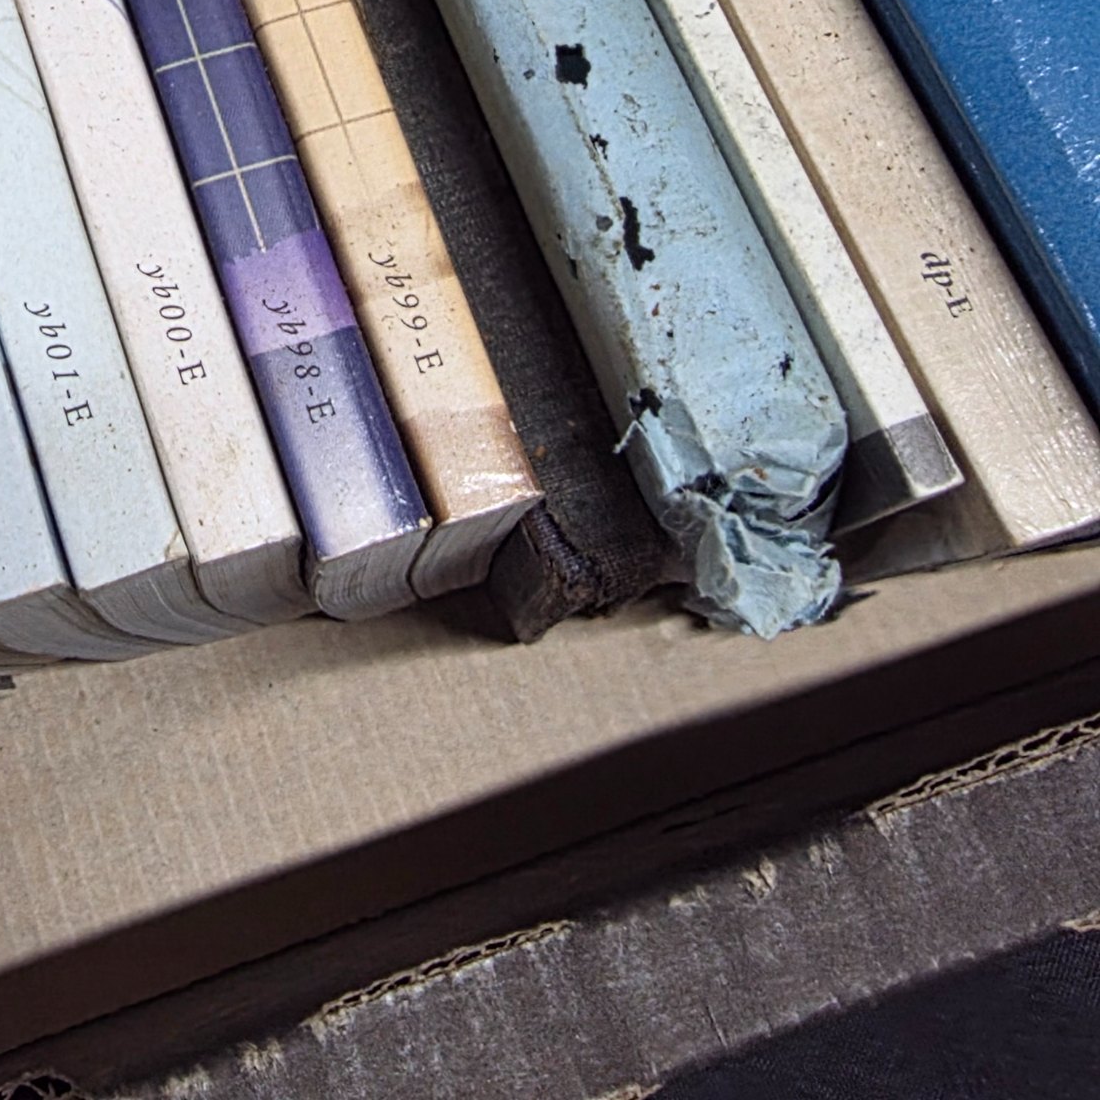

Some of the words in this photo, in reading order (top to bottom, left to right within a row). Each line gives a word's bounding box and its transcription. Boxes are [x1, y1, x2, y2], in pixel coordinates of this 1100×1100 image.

[136, 261, 208, 387] yb00-E
[367, 251, 445, 376] yb99-E
[920, 250, 974, 320] dp-E
[23, 301, 95, 428] yb01-E
[261, 297, 337, 426] yb98-E
